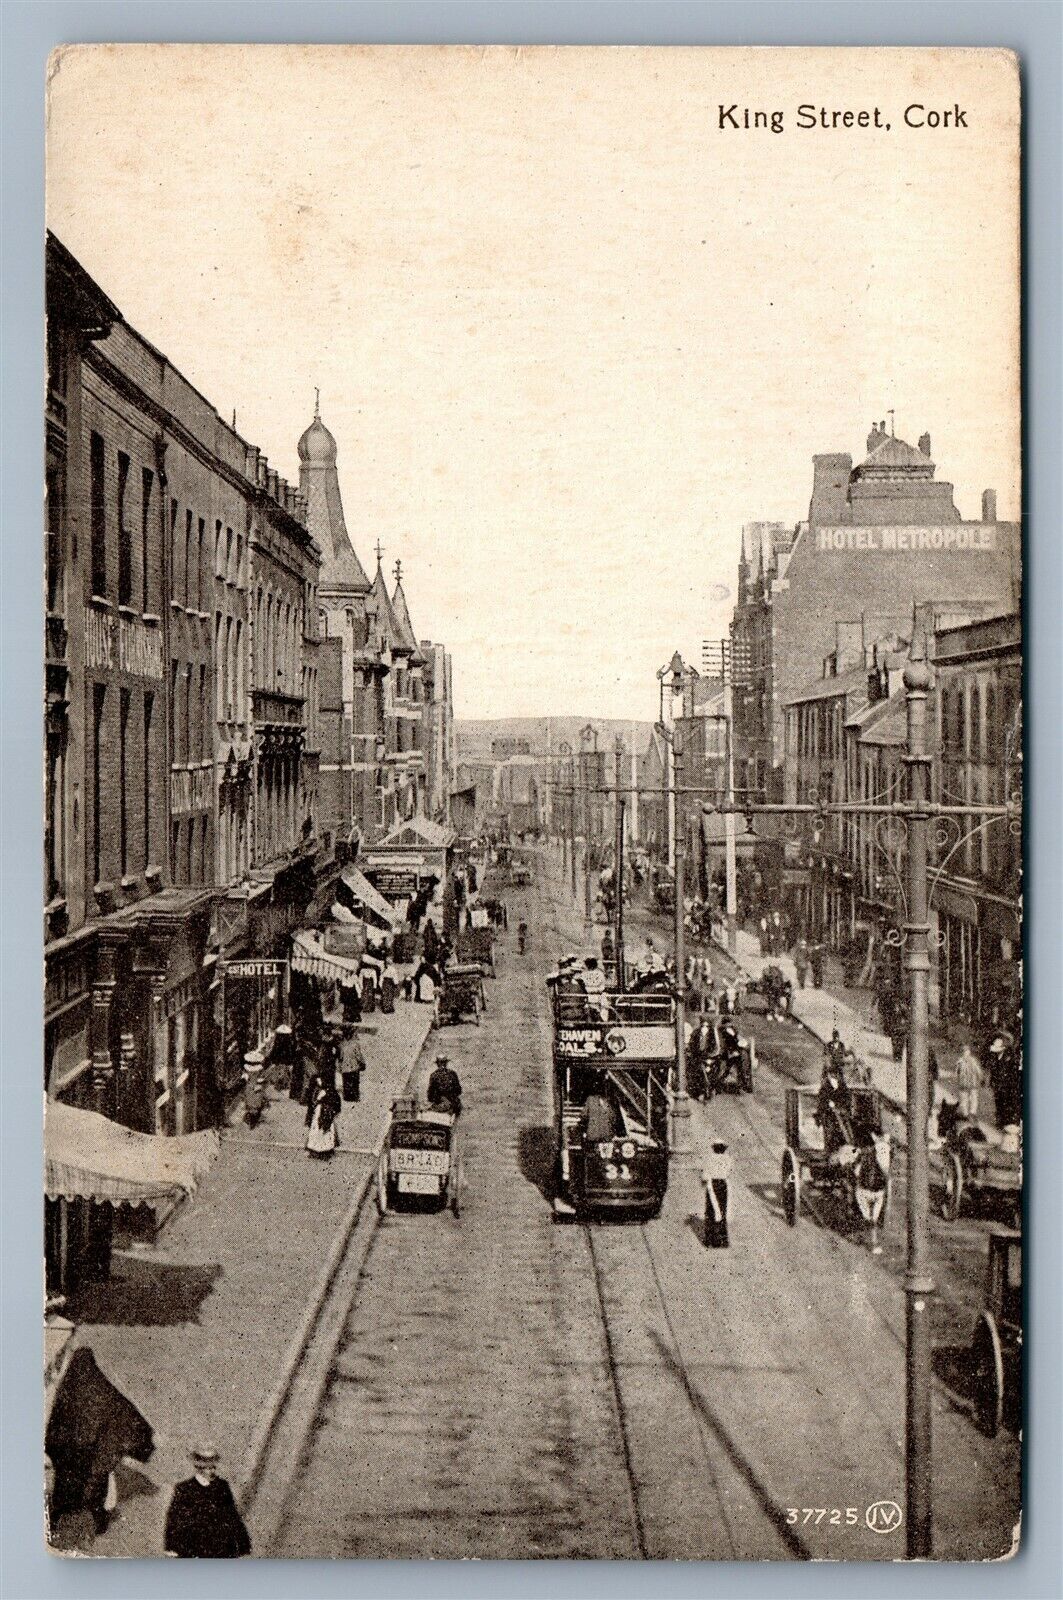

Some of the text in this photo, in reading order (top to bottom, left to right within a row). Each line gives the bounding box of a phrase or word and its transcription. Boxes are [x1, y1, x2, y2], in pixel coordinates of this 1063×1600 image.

[820, 527, 996, 549] HOTEL METROPOLE
[240, 963, 281, 976] HOTEL
